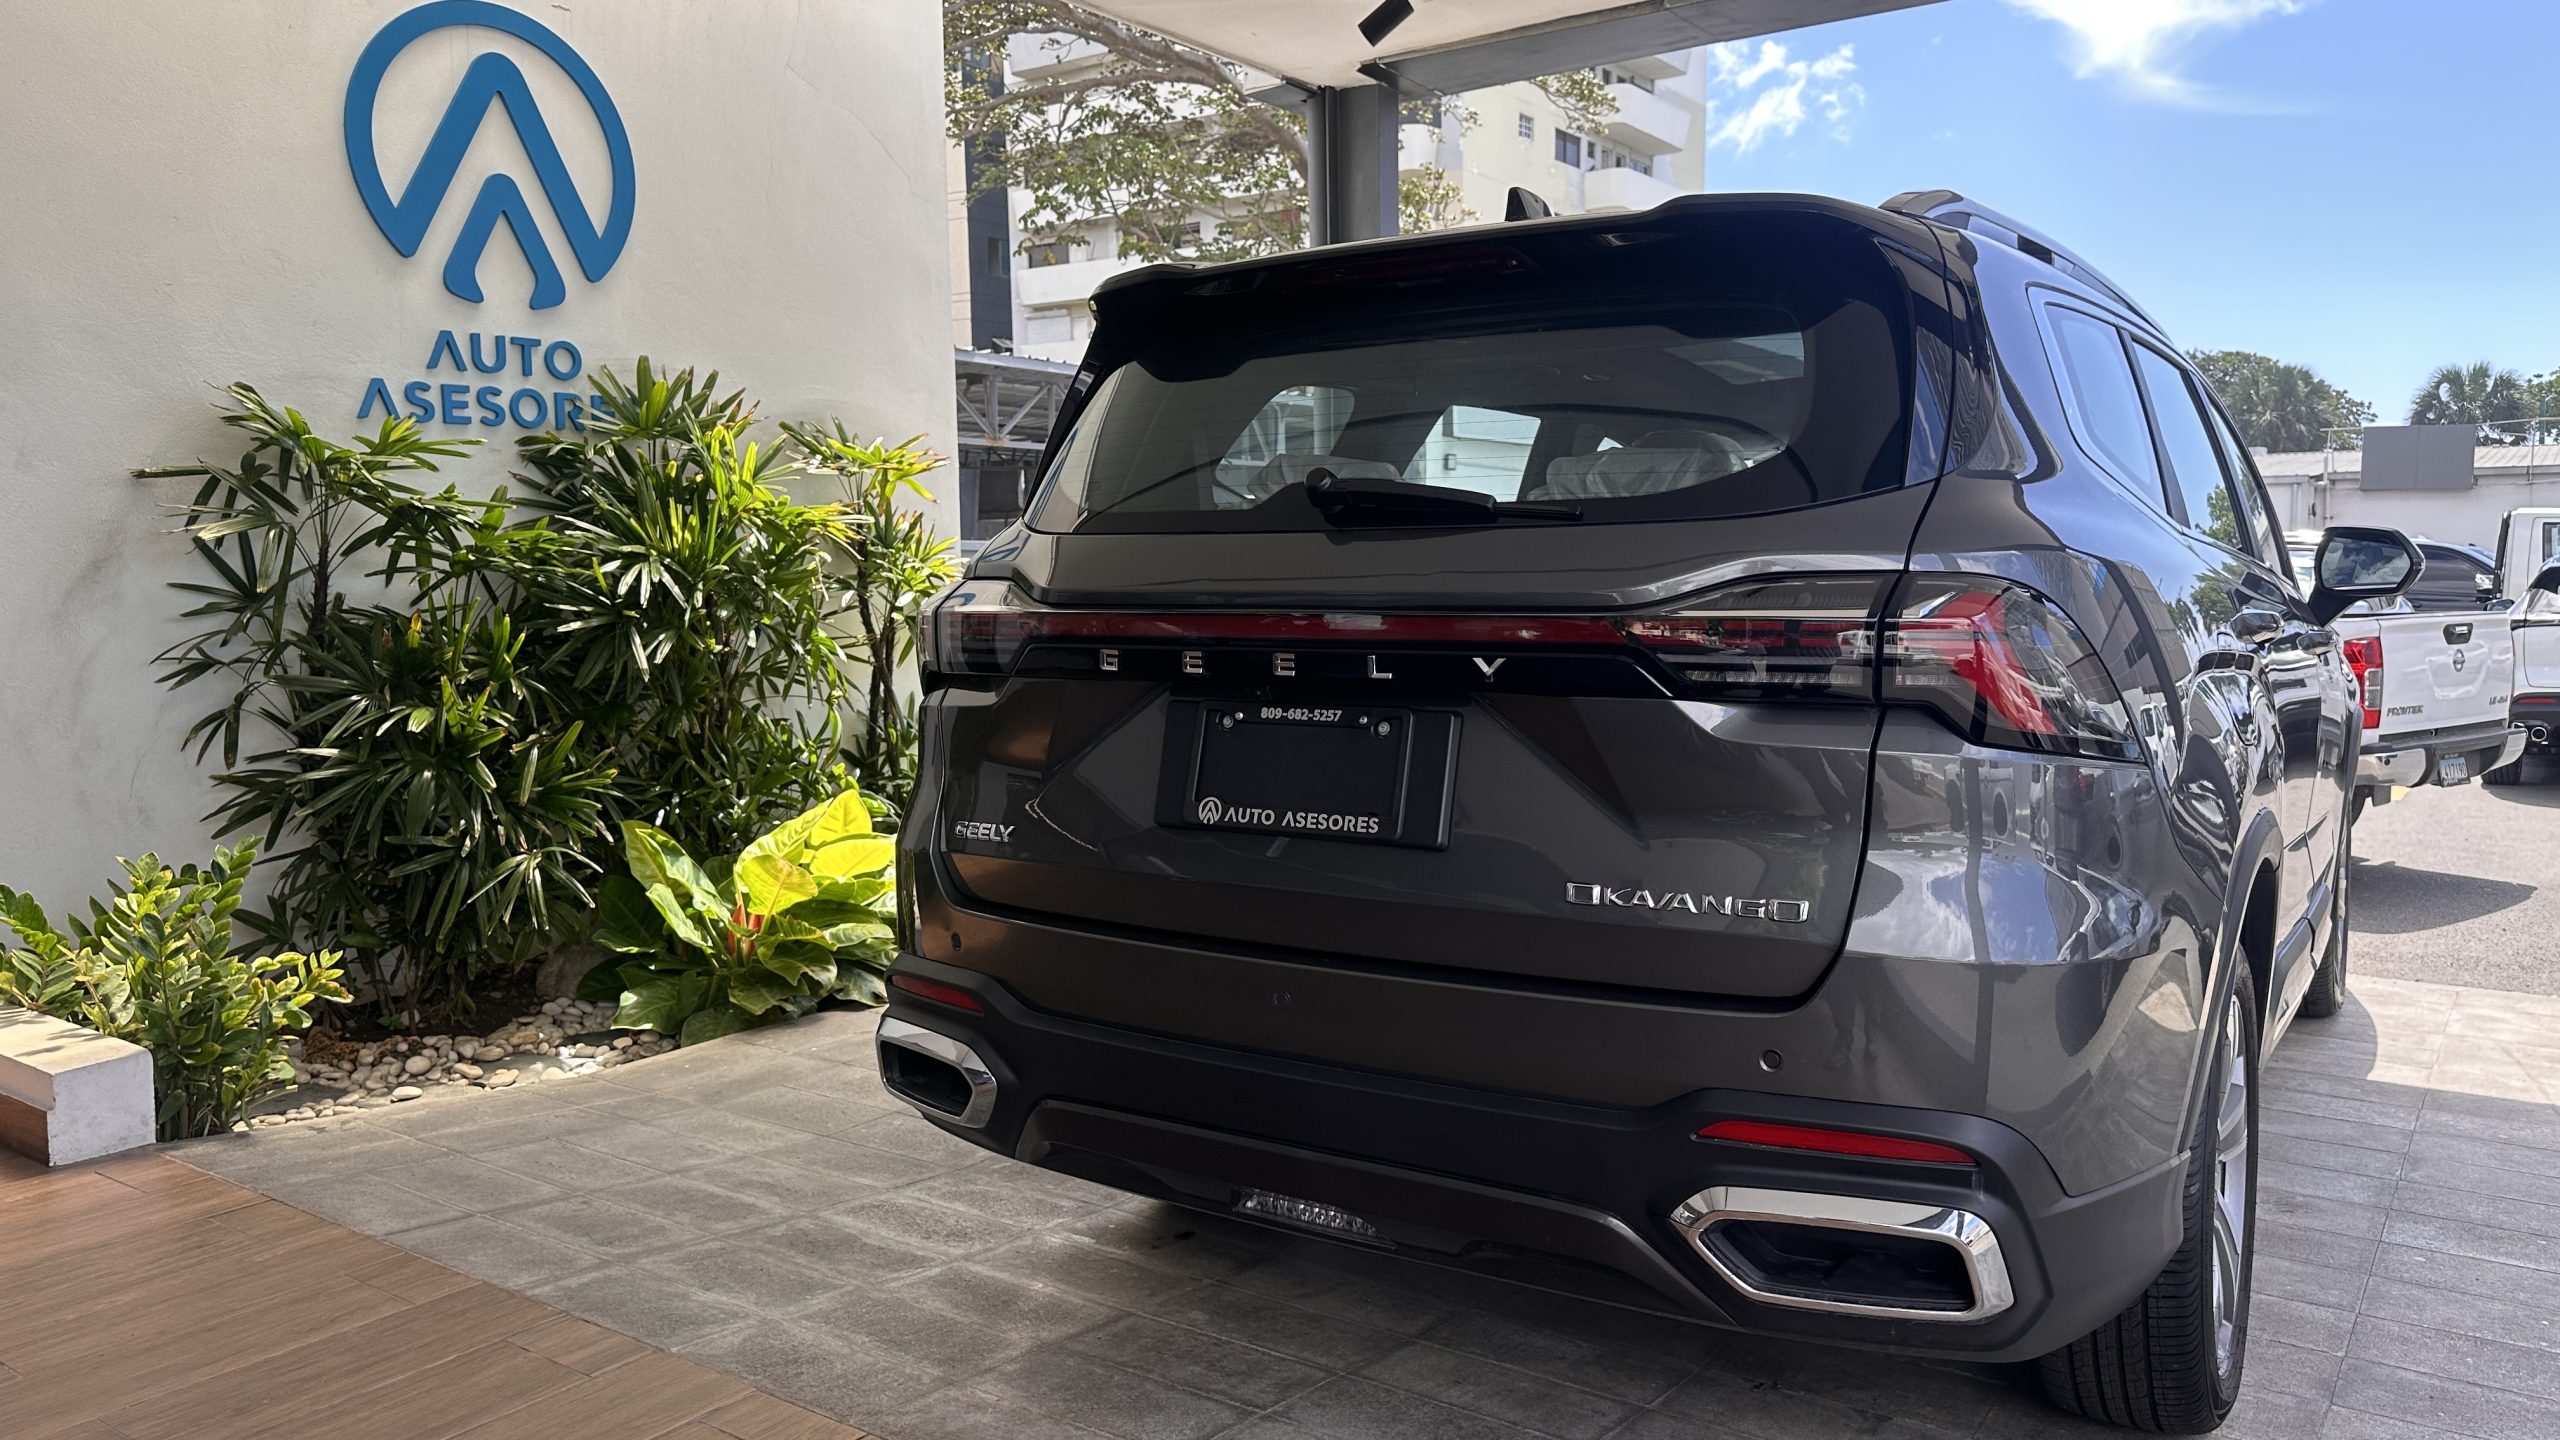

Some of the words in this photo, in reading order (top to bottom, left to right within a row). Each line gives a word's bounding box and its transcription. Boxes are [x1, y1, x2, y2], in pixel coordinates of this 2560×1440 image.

[426, 330, 582, 381] AUTO
[357, 378, 641, 434] ASESORE
[1100, 648, 1506, 682] GEELY
[1260, 706, 1342, 722] 809-682-5257
[955, 821, 1015, 842] GEELY
[1224, 807, 1276, 826] AUTO
[1281, 811, 1380, 834] ASESORES
[1565, 882, 1810, 923] OKAVANGO
